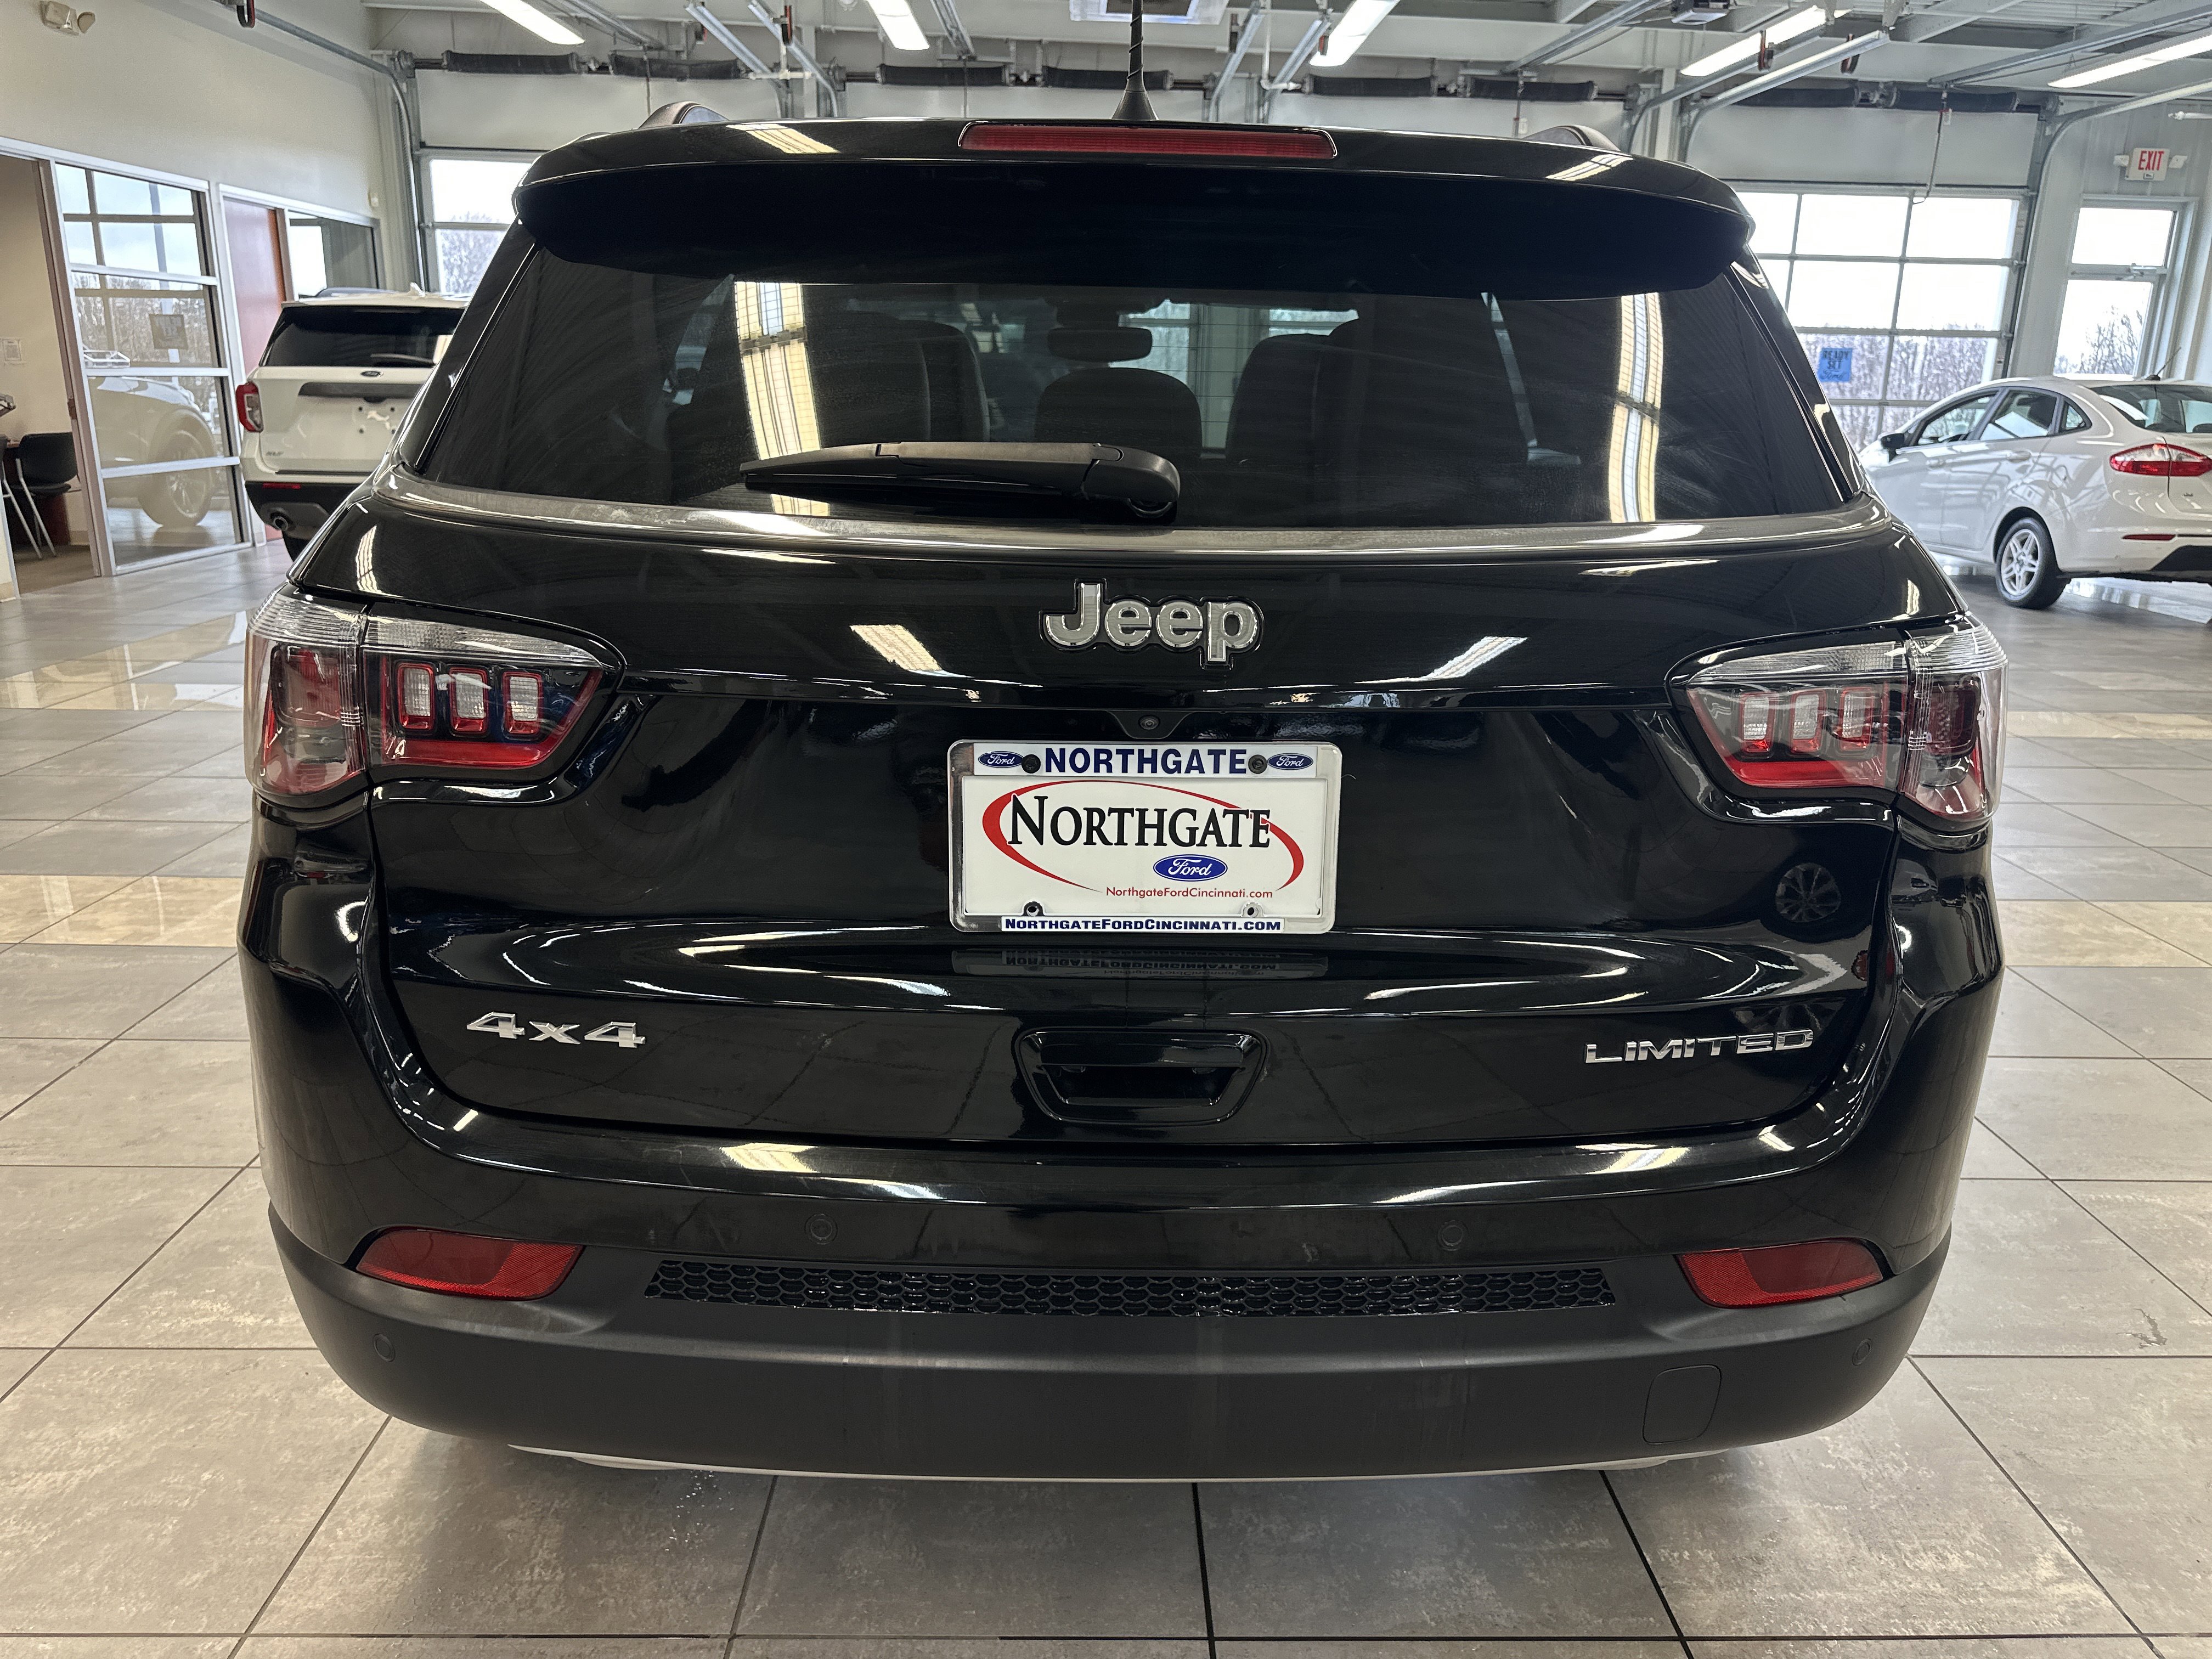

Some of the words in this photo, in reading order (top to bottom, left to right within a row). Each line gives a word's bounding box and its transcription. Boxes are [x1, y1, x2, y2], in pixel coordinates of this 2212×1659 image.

[2138, 150, 2165, 170] EXIT
[1045, 583, 1258, 662] Jeep
[987, 753, 1015, 765] Ford
[1045, 747, 1247, 774] NORTHGATE
[1276, 755, 1305, 767] Ford
[1008, 794, 1271, 847] NORTHGATE
[1167, 857, 1212, 877] Ford
[1106, 886, 1273, 899] NorthgateFordCincinnati.com
[1005, 918, 1281, 930] NORTHGATEFORDCINCINNATI.COM
[466, 1012, 646, 1048] 4x4
[1585, 1029, 1814, 1063] LIMITED
